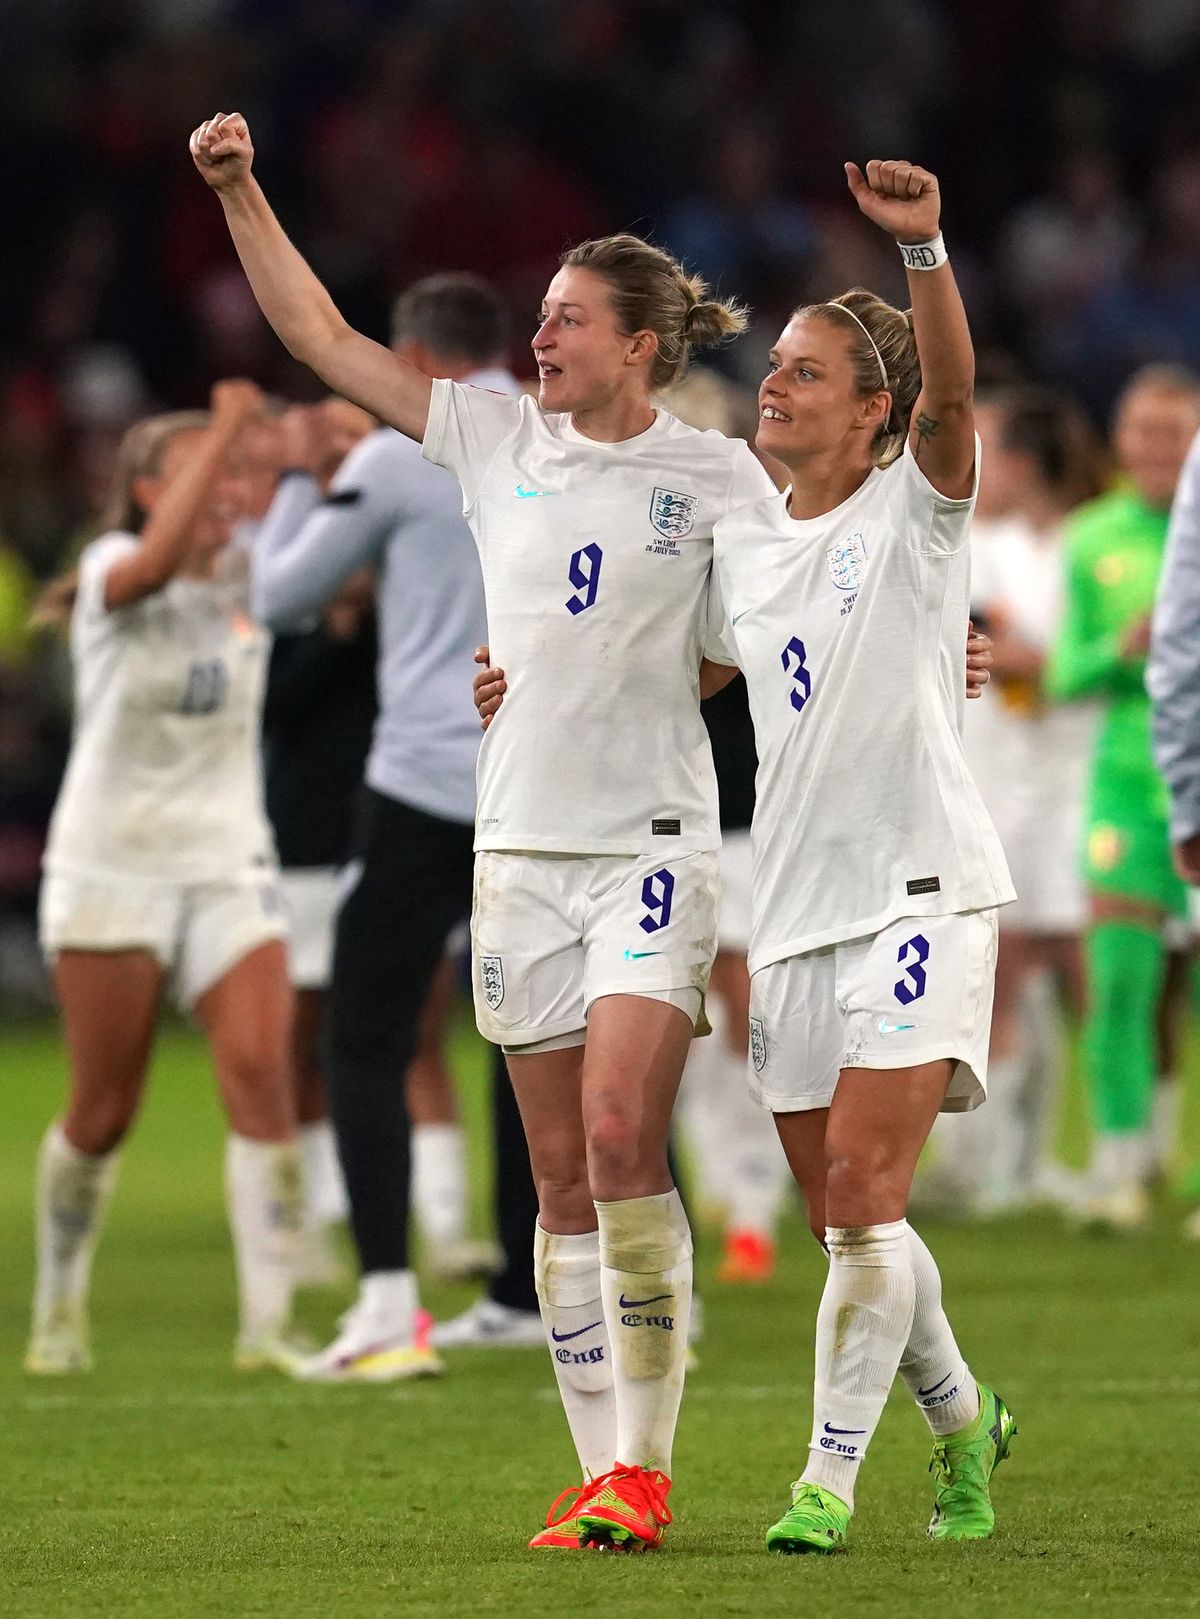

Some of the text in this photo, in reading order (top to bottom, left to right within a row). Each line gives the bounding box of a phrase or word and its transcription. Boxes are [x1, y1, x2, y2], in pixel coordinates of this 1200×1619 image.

[565, 542, 603, 616] 9
[653, 546, 668, 555] JULY
[781, 636, 811, 713] 3
[638, 868, 675, 934] 9
[894, 934, 930, 1006] 3
[556, 1346, 604, 1364] Eng
[621, 1313, 674, 1331] Eng
